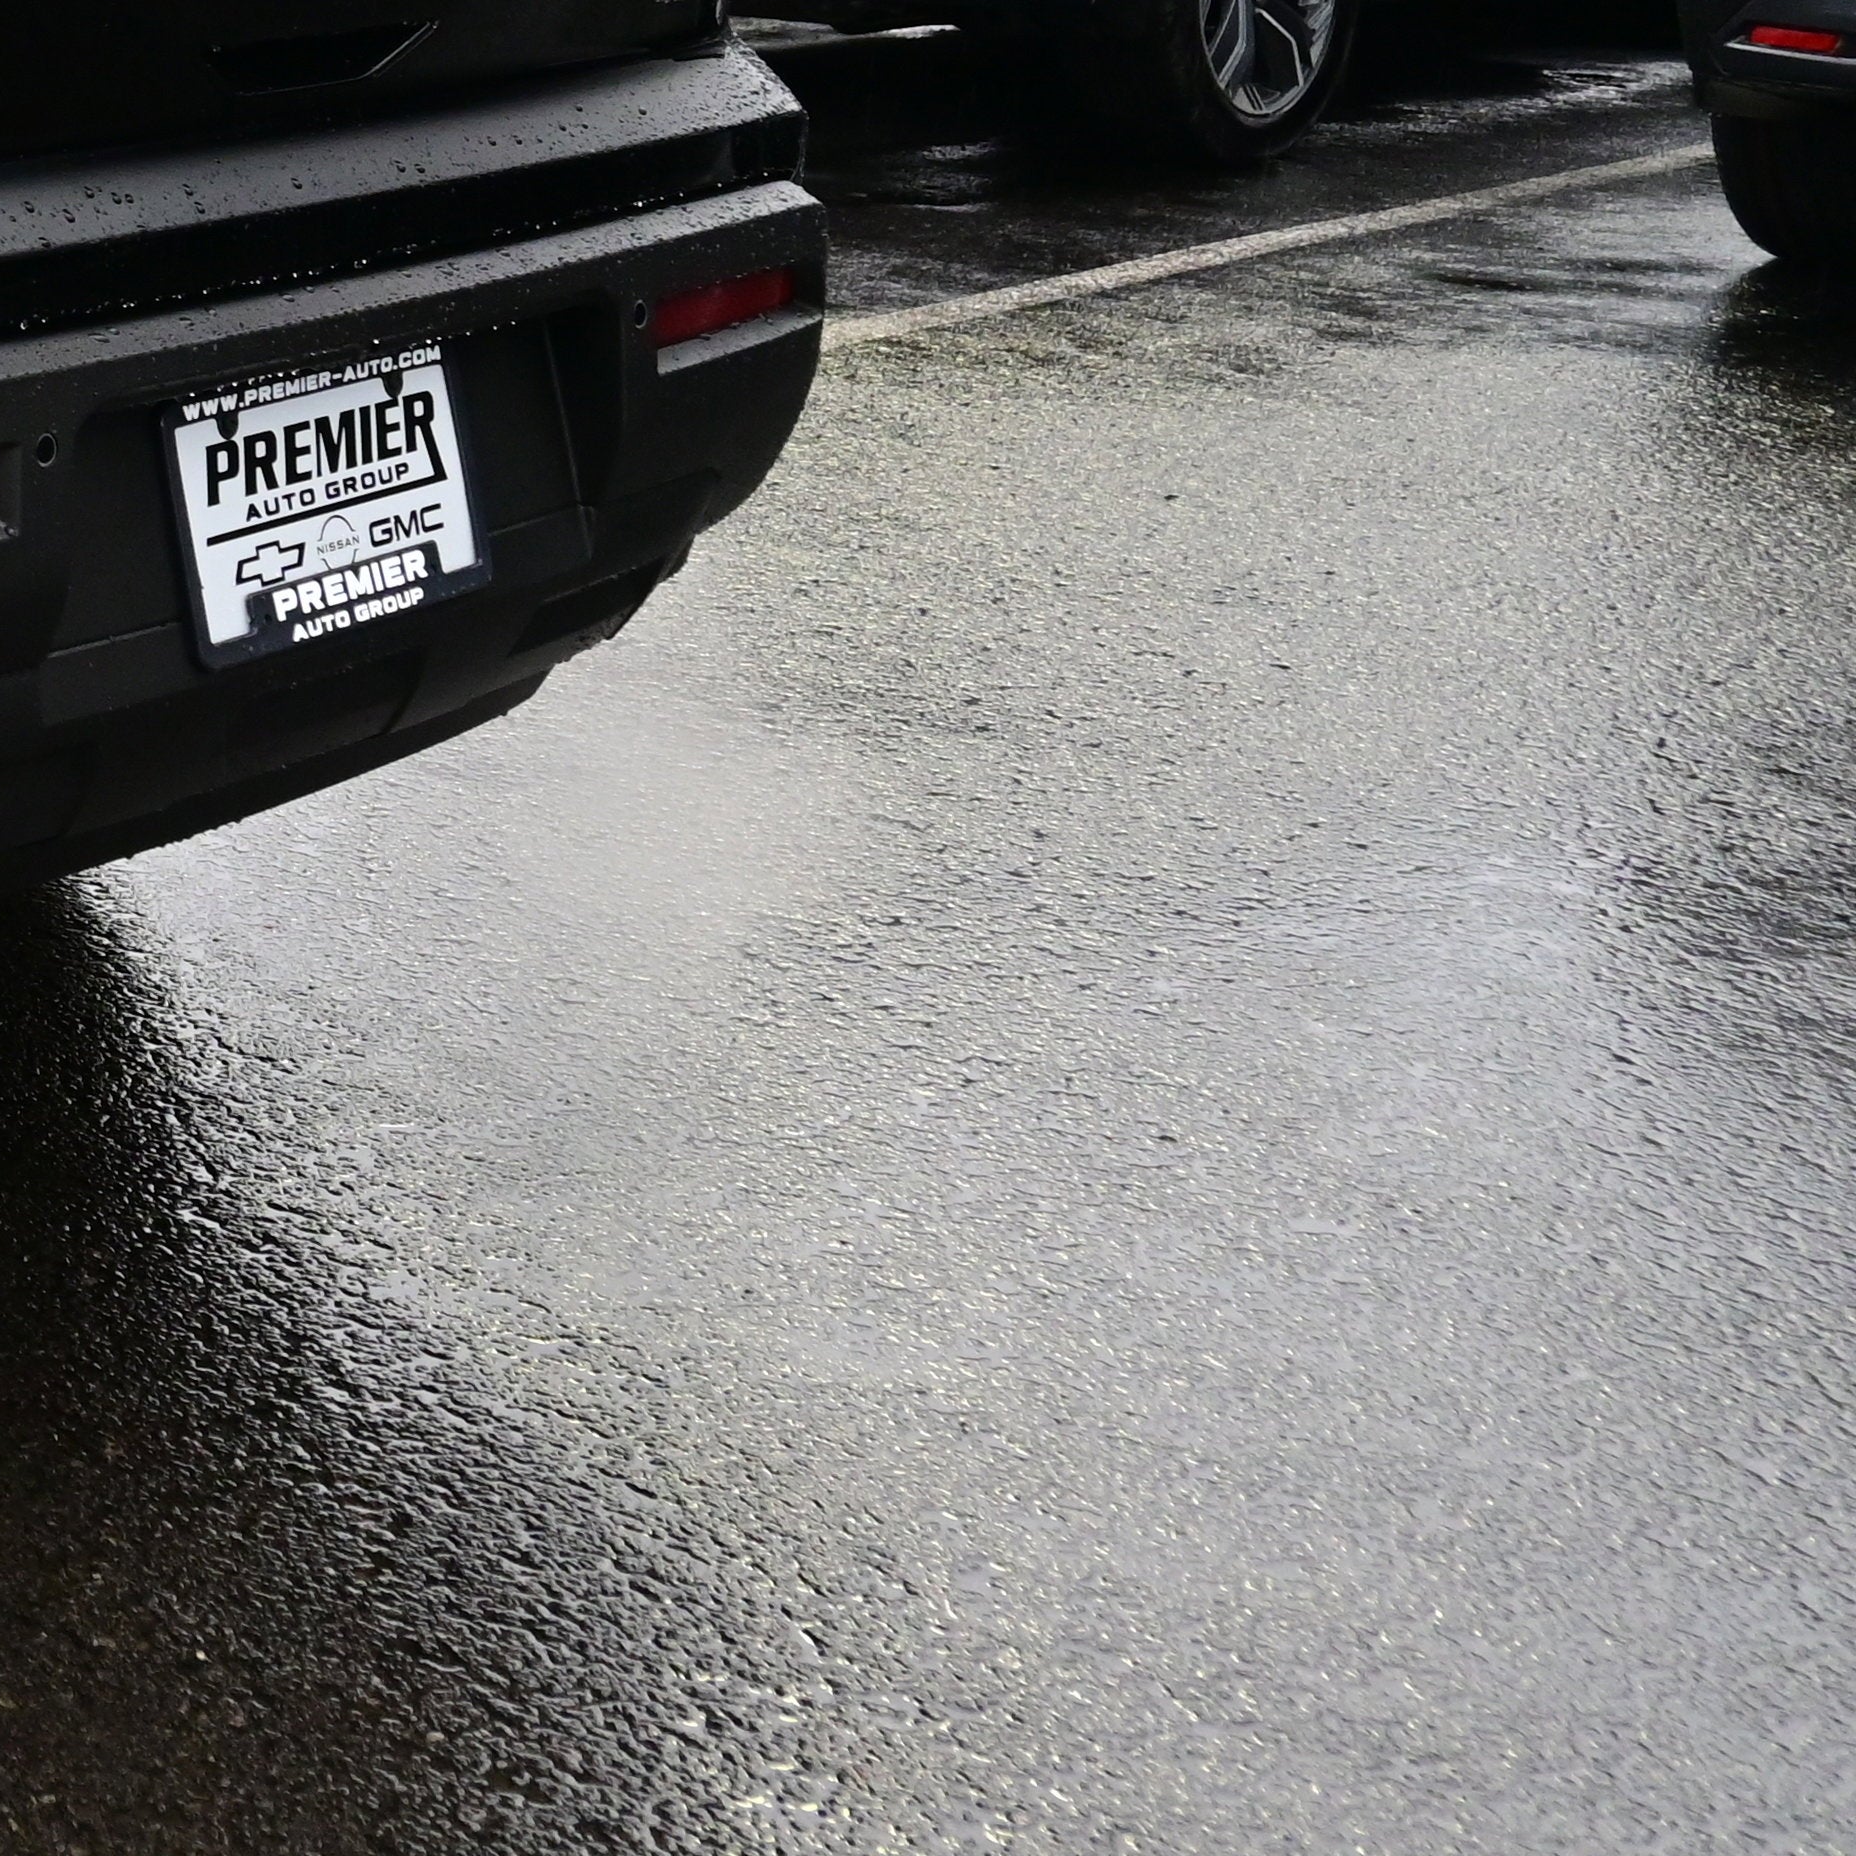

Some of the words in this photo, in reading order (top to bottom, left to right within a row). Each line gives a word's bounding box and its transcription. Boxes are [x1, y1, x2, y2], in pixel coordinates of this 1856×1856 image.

[182, 345, 442, 422] WWW.PREMIER-AUTO.COM
[205, 390, 447, 509] PREMIER
[245, 488, 316, 522] AUTO
[325, 462, 410, 500] GROUP
[316, 535, 361, 556] NISSAN
[369, 503, 445, 547] GMC
[272, 549, 429, 622] PREMIER
[292, 611, 351, 643] AUTO
[353, 587, 425, 623] GROUP
